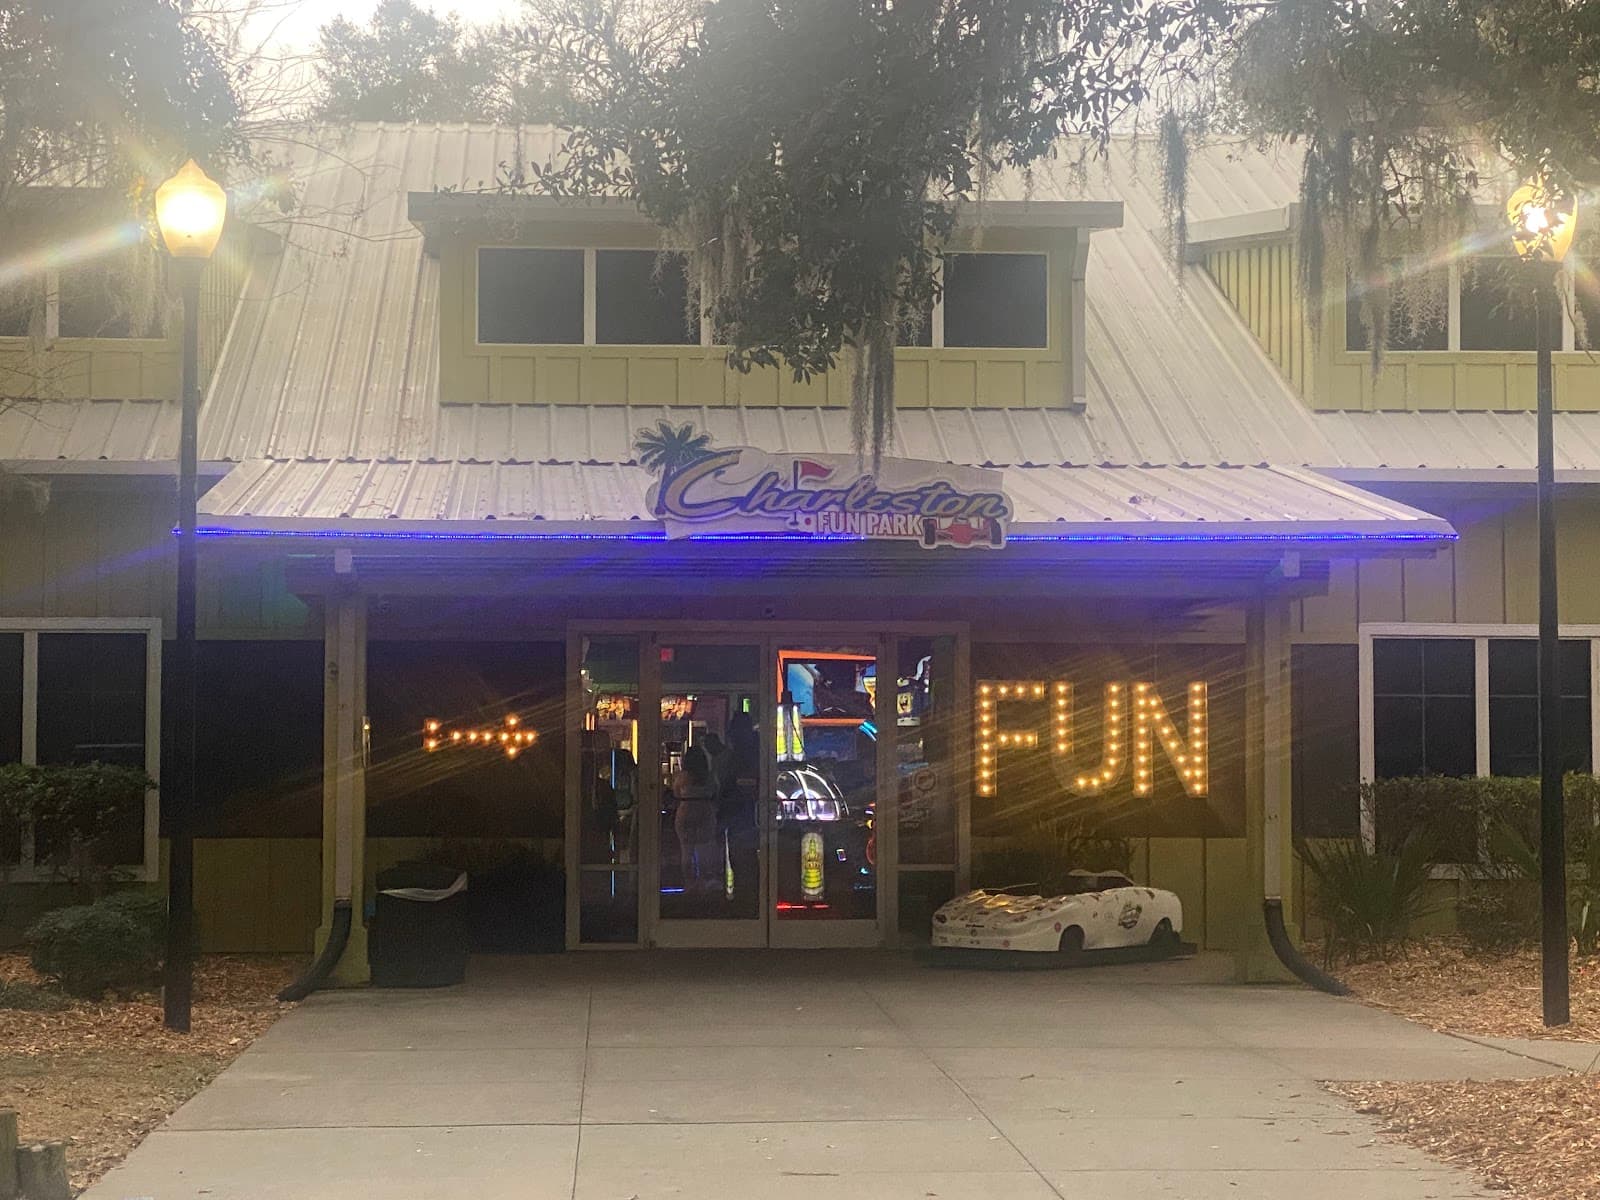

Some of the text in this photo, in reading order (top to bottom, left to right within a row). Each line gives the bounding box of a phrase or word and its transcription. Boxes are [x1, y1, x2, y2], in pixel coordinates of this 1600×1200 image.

[664, 448, 1008, 518] Charleston
[817, 511, 922, 536] FUN PARK
[975, 680, 1208, 798] FUN
